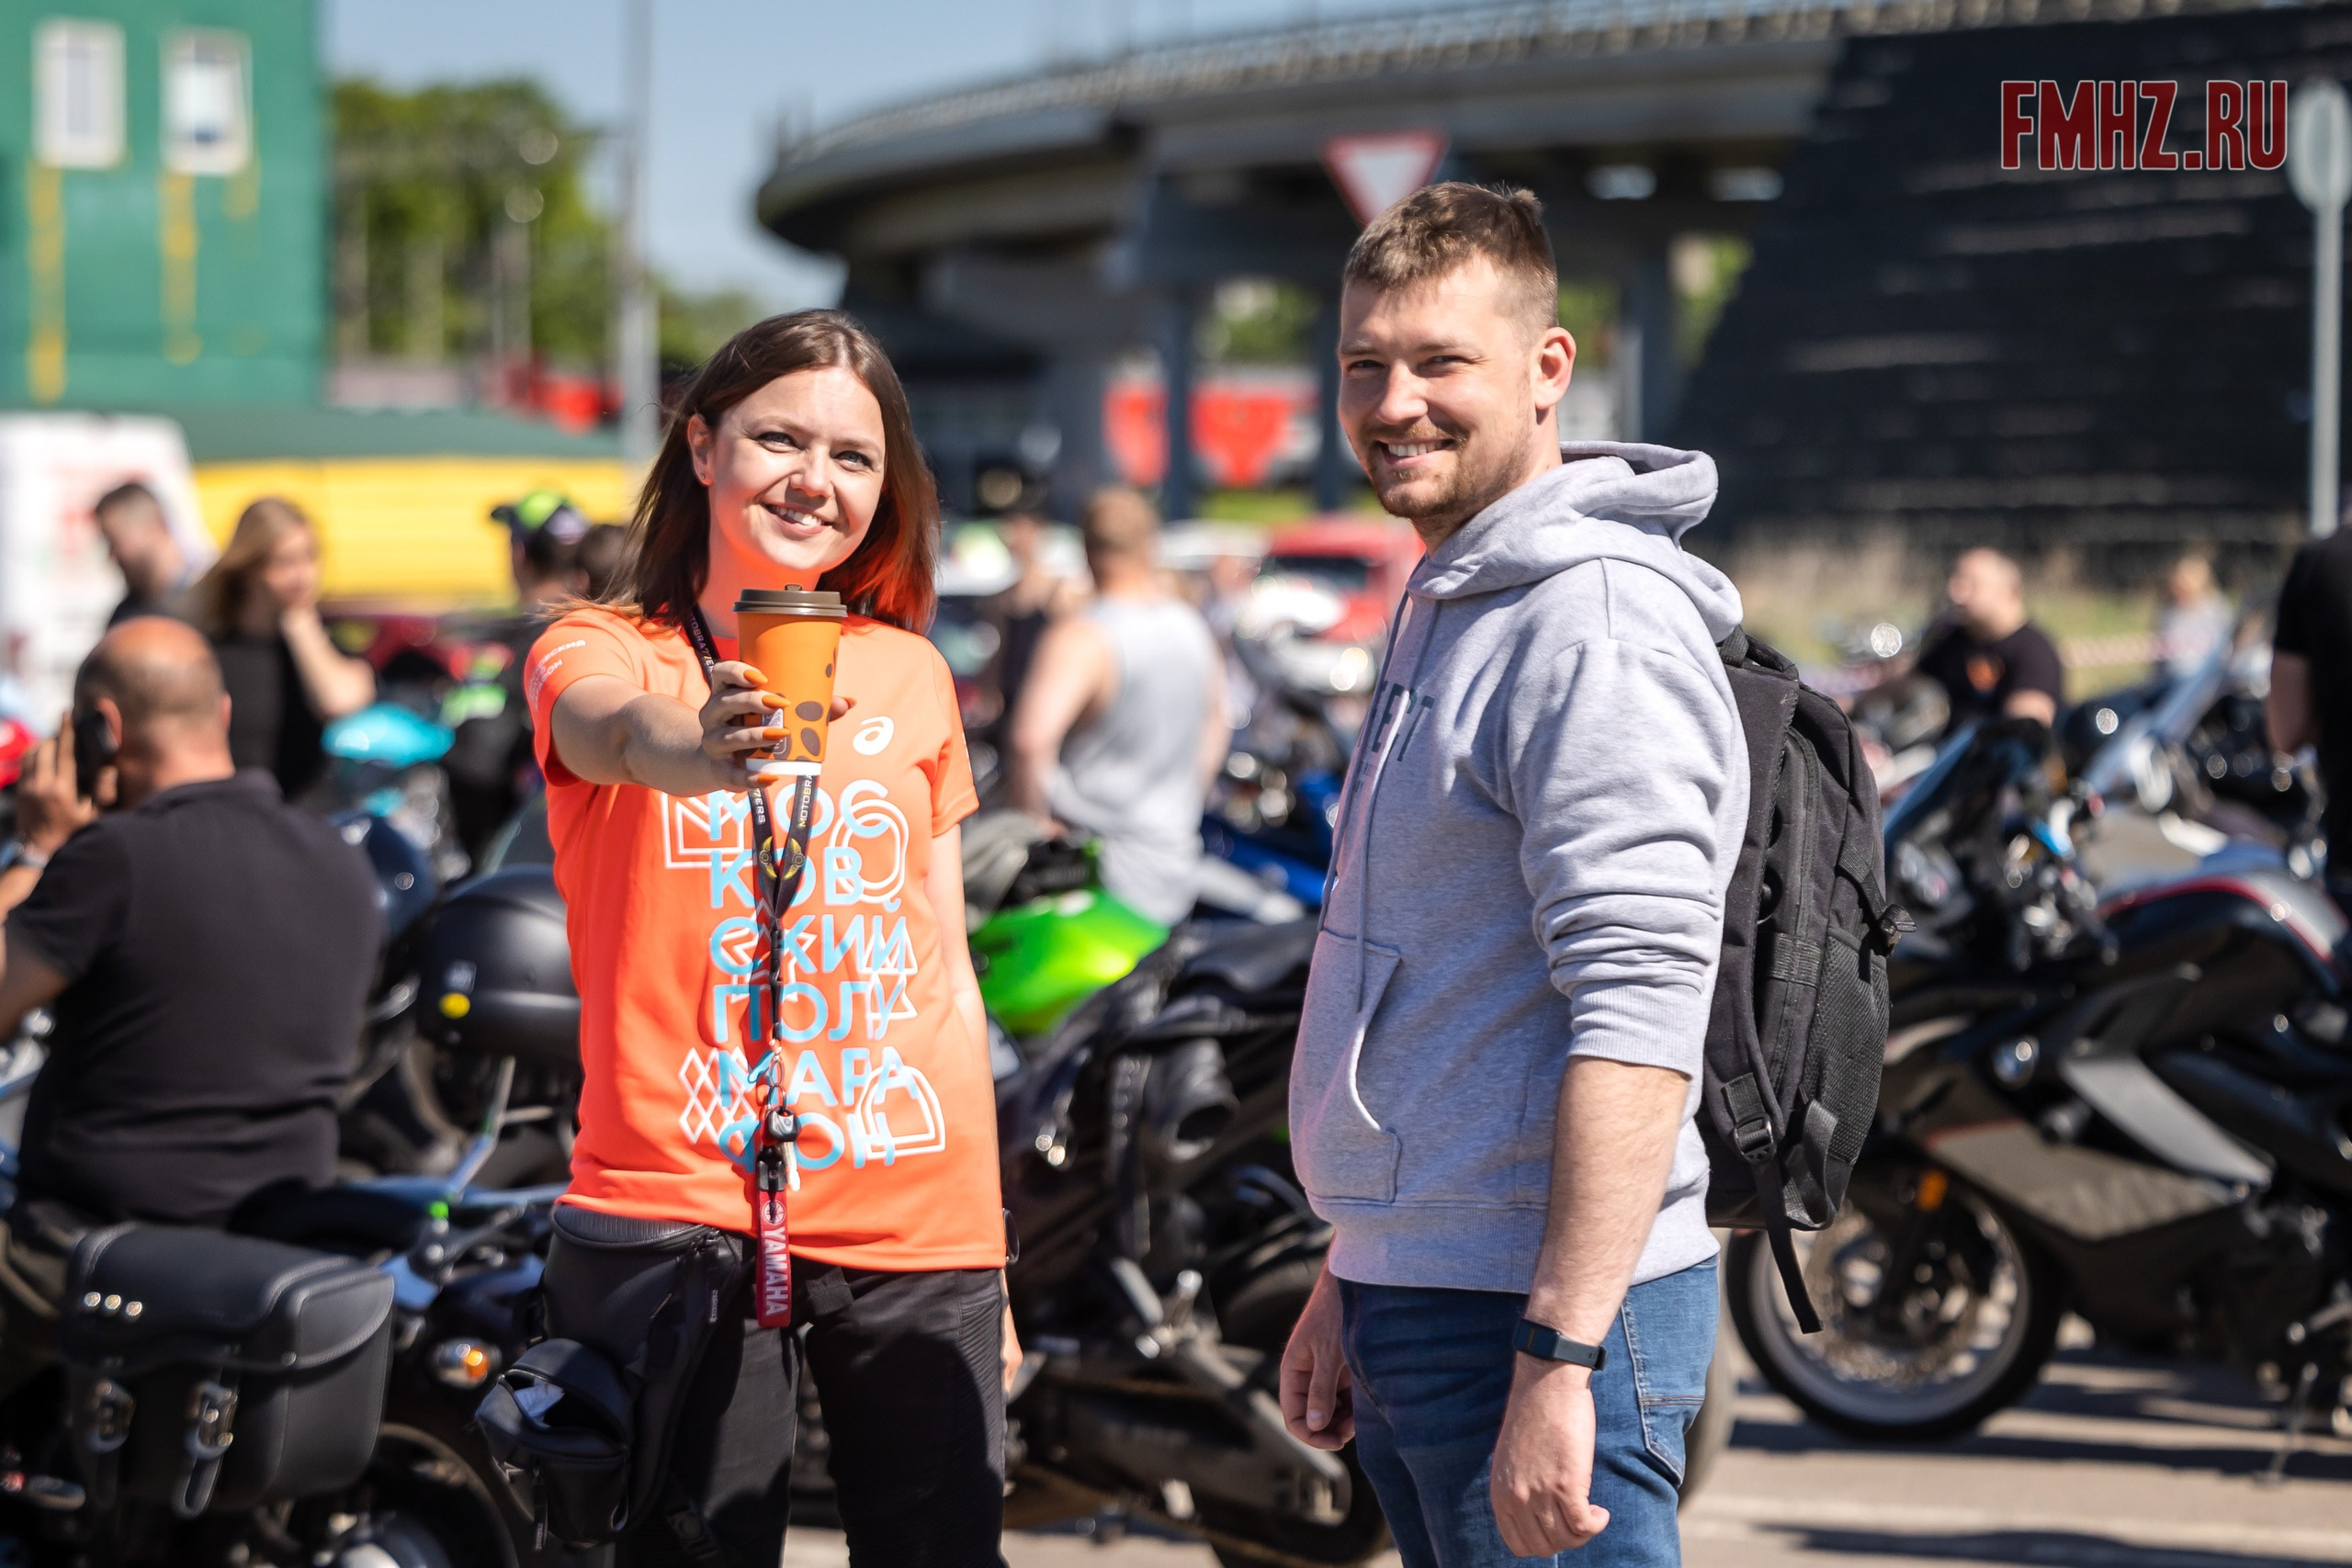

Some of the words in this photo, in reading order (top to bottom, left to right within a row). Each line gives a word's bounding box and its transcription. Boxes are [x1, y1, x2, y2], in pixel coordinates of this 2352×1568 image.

[798, 774, 814, 828] MOTOBRA
[712, 980, 906, 1043] ПОЛУ
[718, 1046, 922, 1108] МАРА
[763, 1225, 789, 1316] YAMAHA
